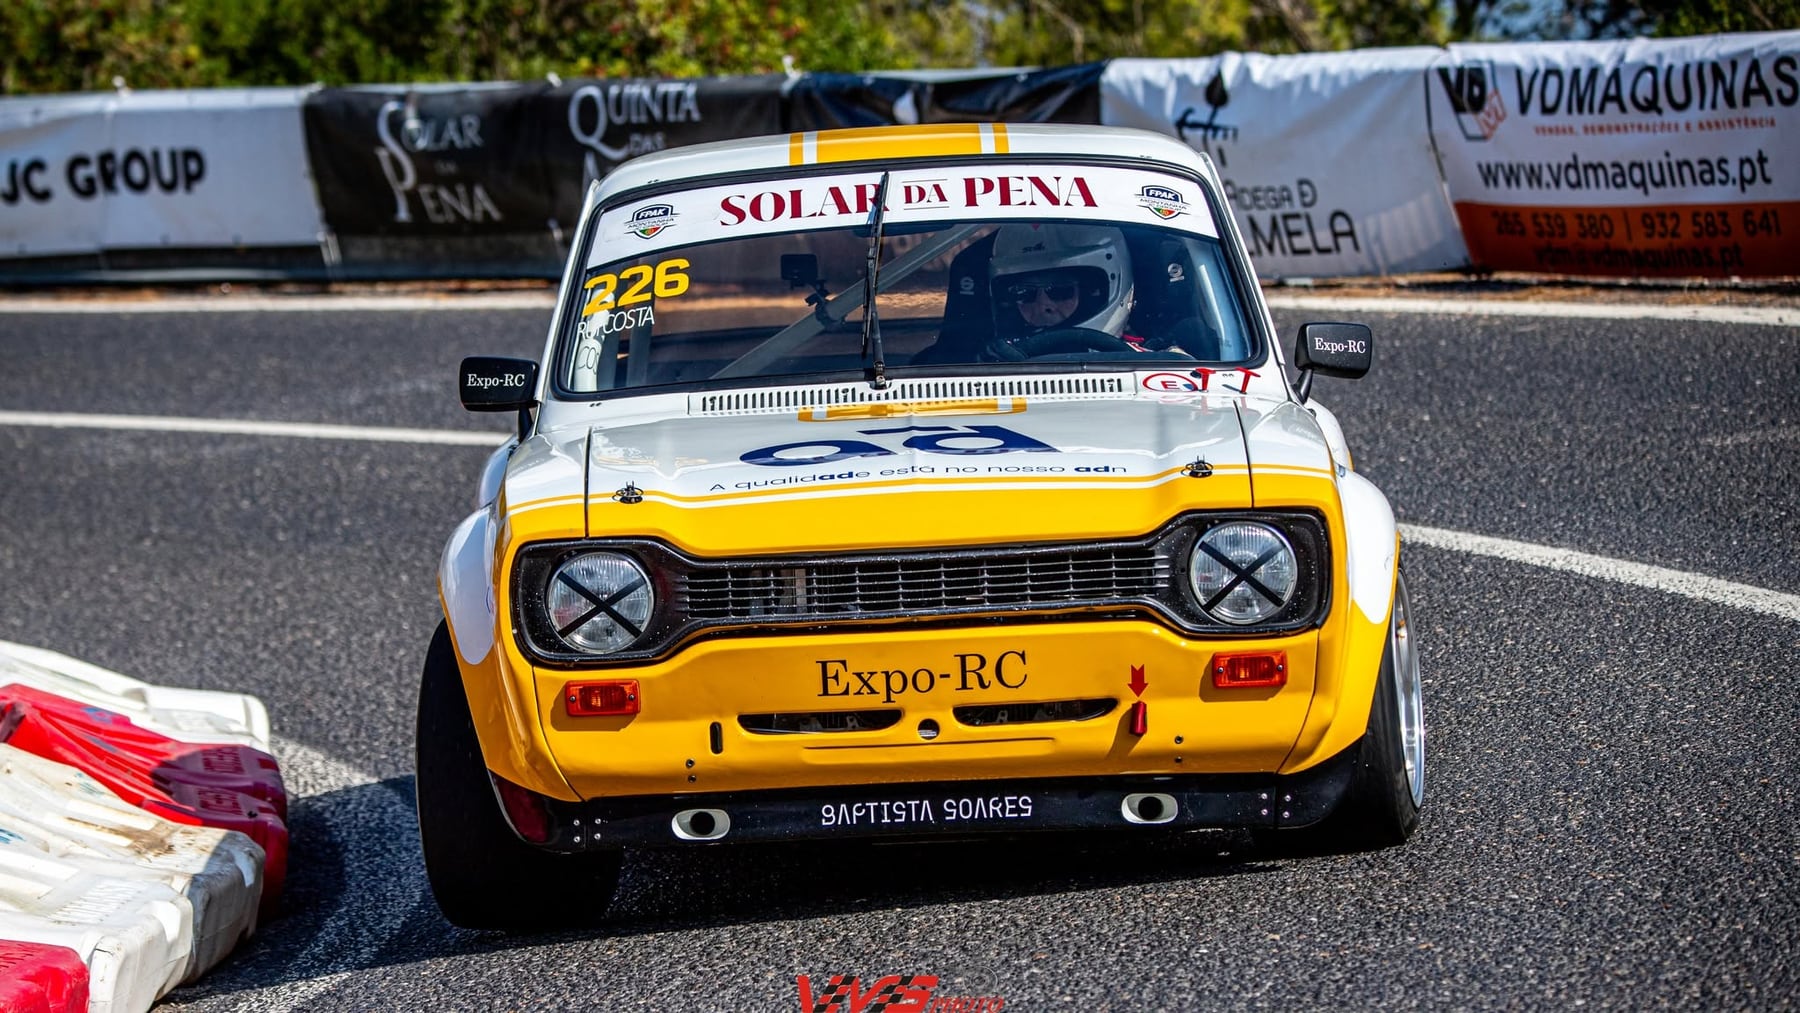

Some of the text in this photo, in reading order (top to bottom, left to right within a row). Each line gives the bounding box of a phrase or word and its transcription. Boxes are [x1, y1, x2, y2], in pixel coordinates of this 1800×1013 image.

[568, 82, 701, 160] QUINTA
[0, 146, 207, 207] JC GROUP
[1477, 149, 1773, 197] www.vdmaquinas.pt
[720, 176, 1099, 227] SOLAR DA PENA
[1148, 189, 1176, 201] FPAK
[637, 207, 666, 220] FPAK
[1532, 212, 1567, 238] 539
[1577, 212, 1614, 238] 380
[1641, 211, 1681, 238] 932
[1692, 209, 1732, 238] 583
[1743, 208, 1782, 236] 641
[583, 258, 690, 317] 226
[603, 306, 655, 334] COSTA
[1314, 337, 1366, 354] Expo-RC
[466, 373, 525, 389] Expo-RC
[710, 483, 726, 491] A
[735, 471, 870, 490] qualidade
[880, 464, 935, 475] está
[1074, 465, 1127, 473] adn
[815, 650, 1028, 704] Expo-RC
[821, 796, 1033, 826] BAPTISTA SOARES
